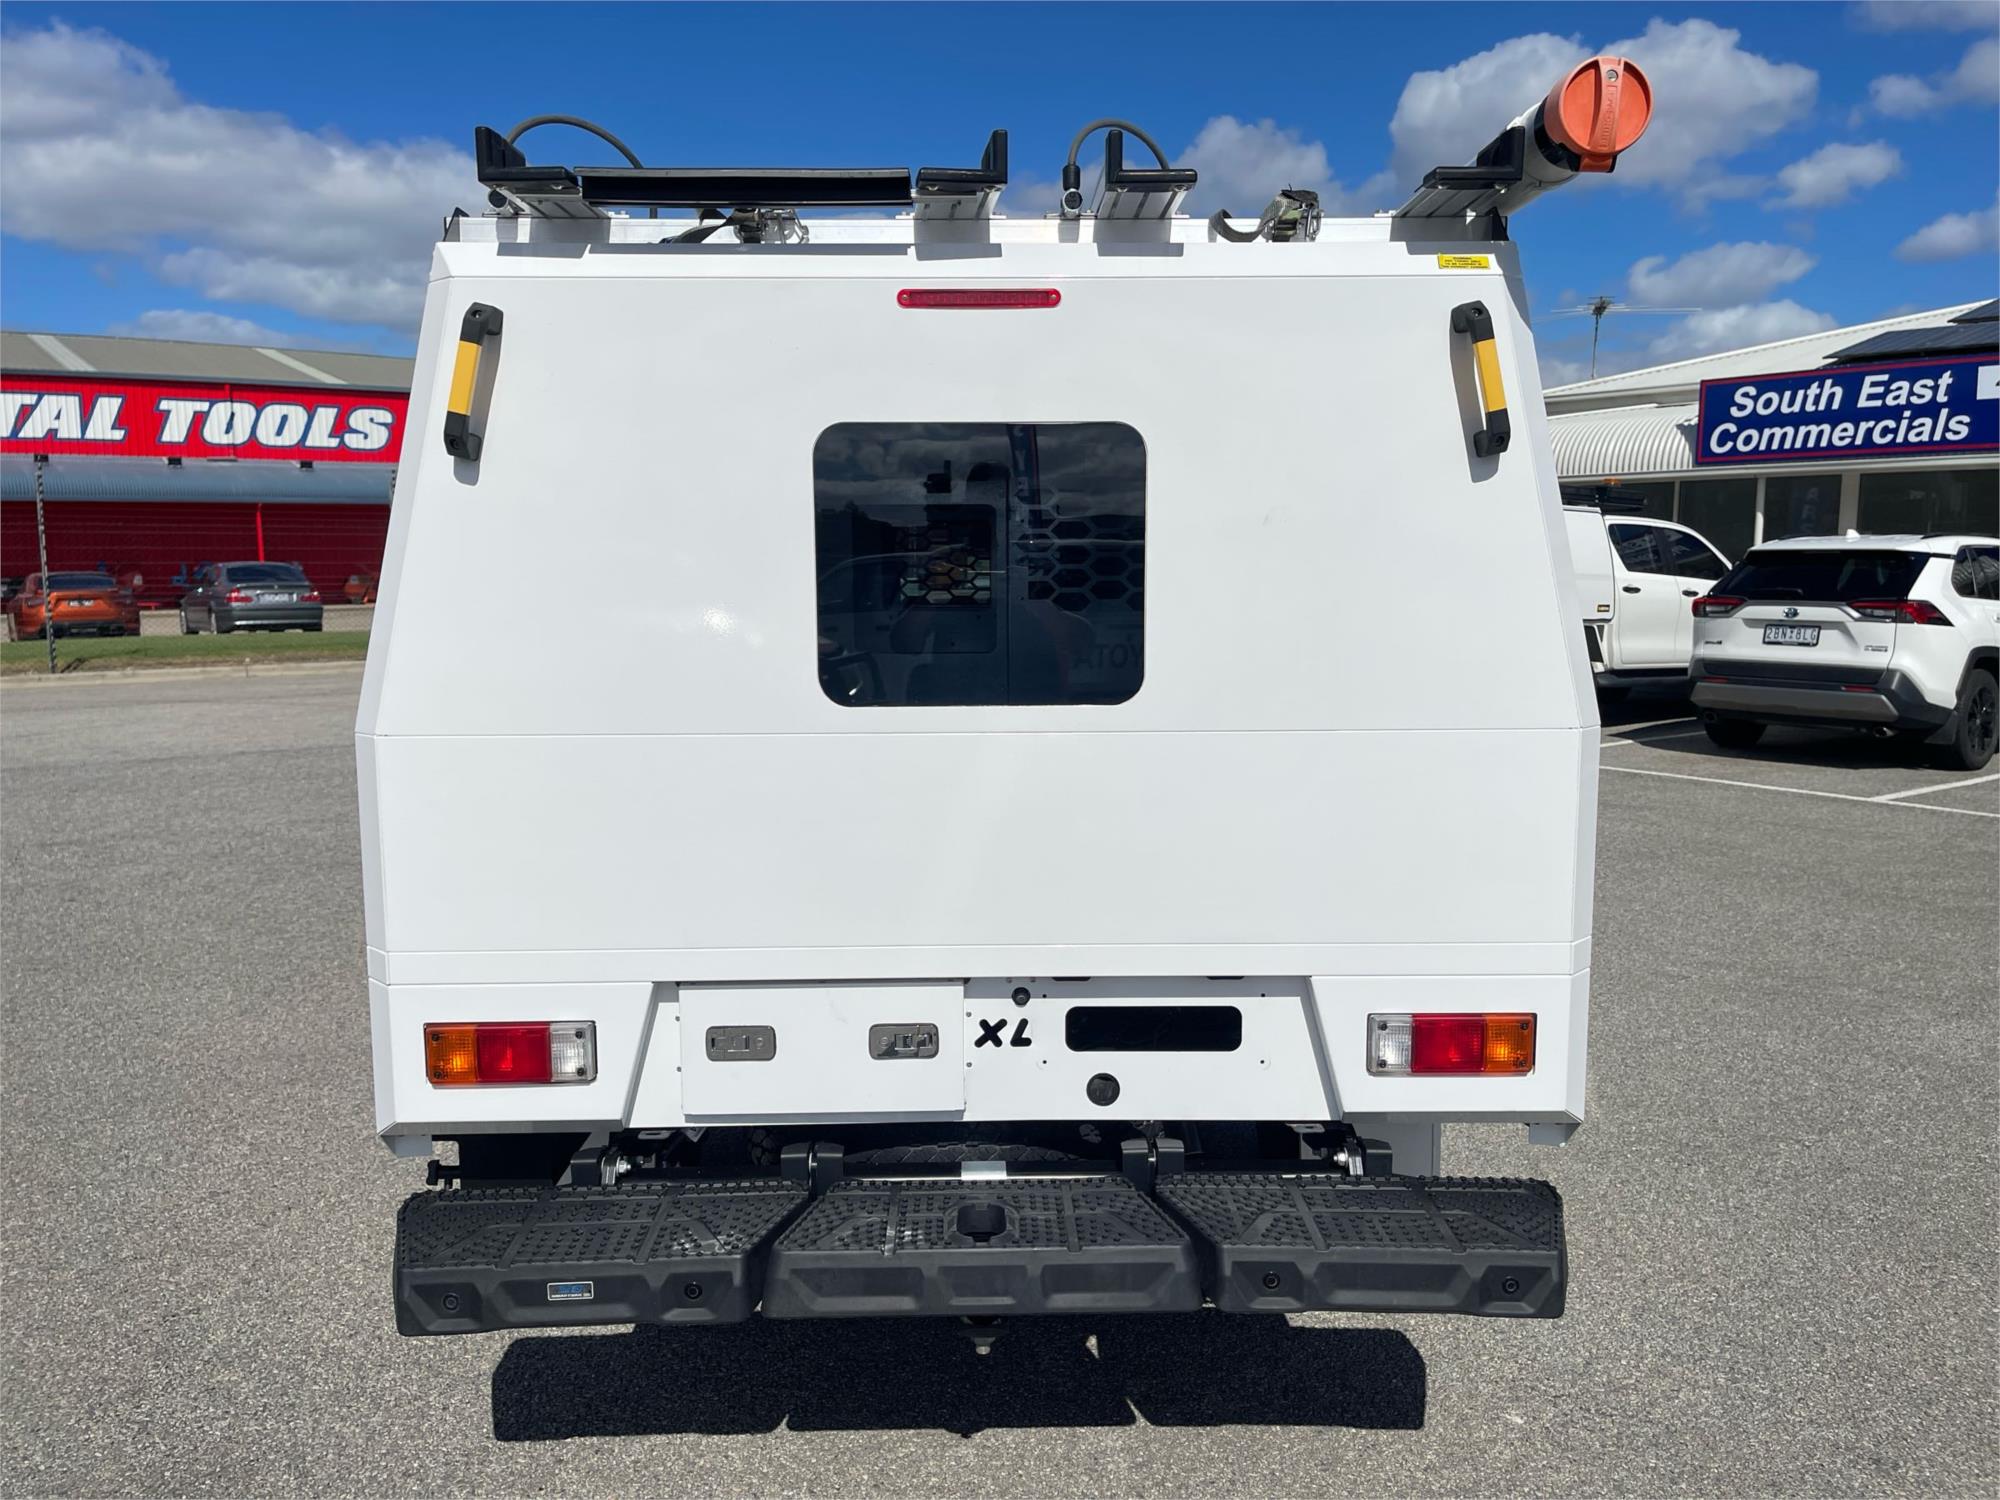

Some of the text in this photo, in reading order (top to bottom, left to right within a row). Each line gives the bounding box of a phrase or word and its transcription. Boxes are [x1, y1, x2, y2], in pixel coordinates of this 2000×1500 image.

[1729, 370, 1953, 418] South East
[158, 399, 393, 450] TOOLS
[1709, 408, 1971, 454] Commercials
[974, 1018, 1032, 1048] XL
